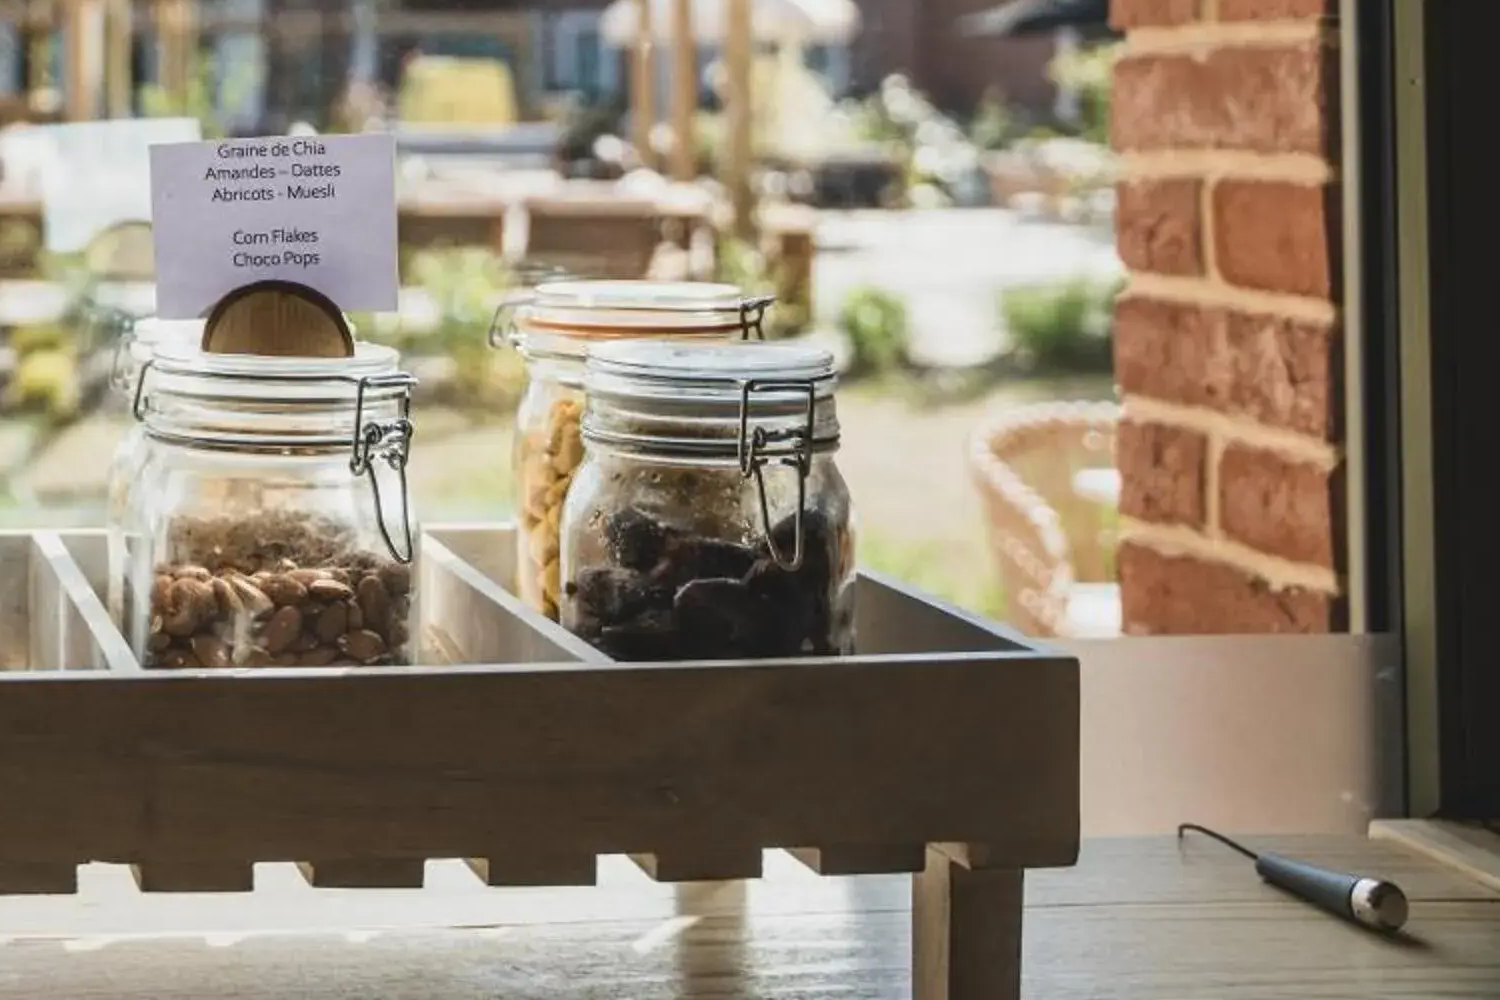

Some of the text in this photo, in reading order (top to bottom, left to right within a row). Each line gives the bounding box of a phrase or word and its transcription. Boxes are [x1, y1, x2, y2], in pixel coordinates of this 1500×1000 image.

[218, 141, 326, 158] Graine de Chia
[205, 166, 276, 180] Amandes
[291, 163, 341, 177] Dattes
[212, 188, 274, 202] Abricots
[287, 184, 335, 199] Muesli
[233, 228, 319, 245] Corn Flakes
[233, 251, 320, 269] Choco Pops
